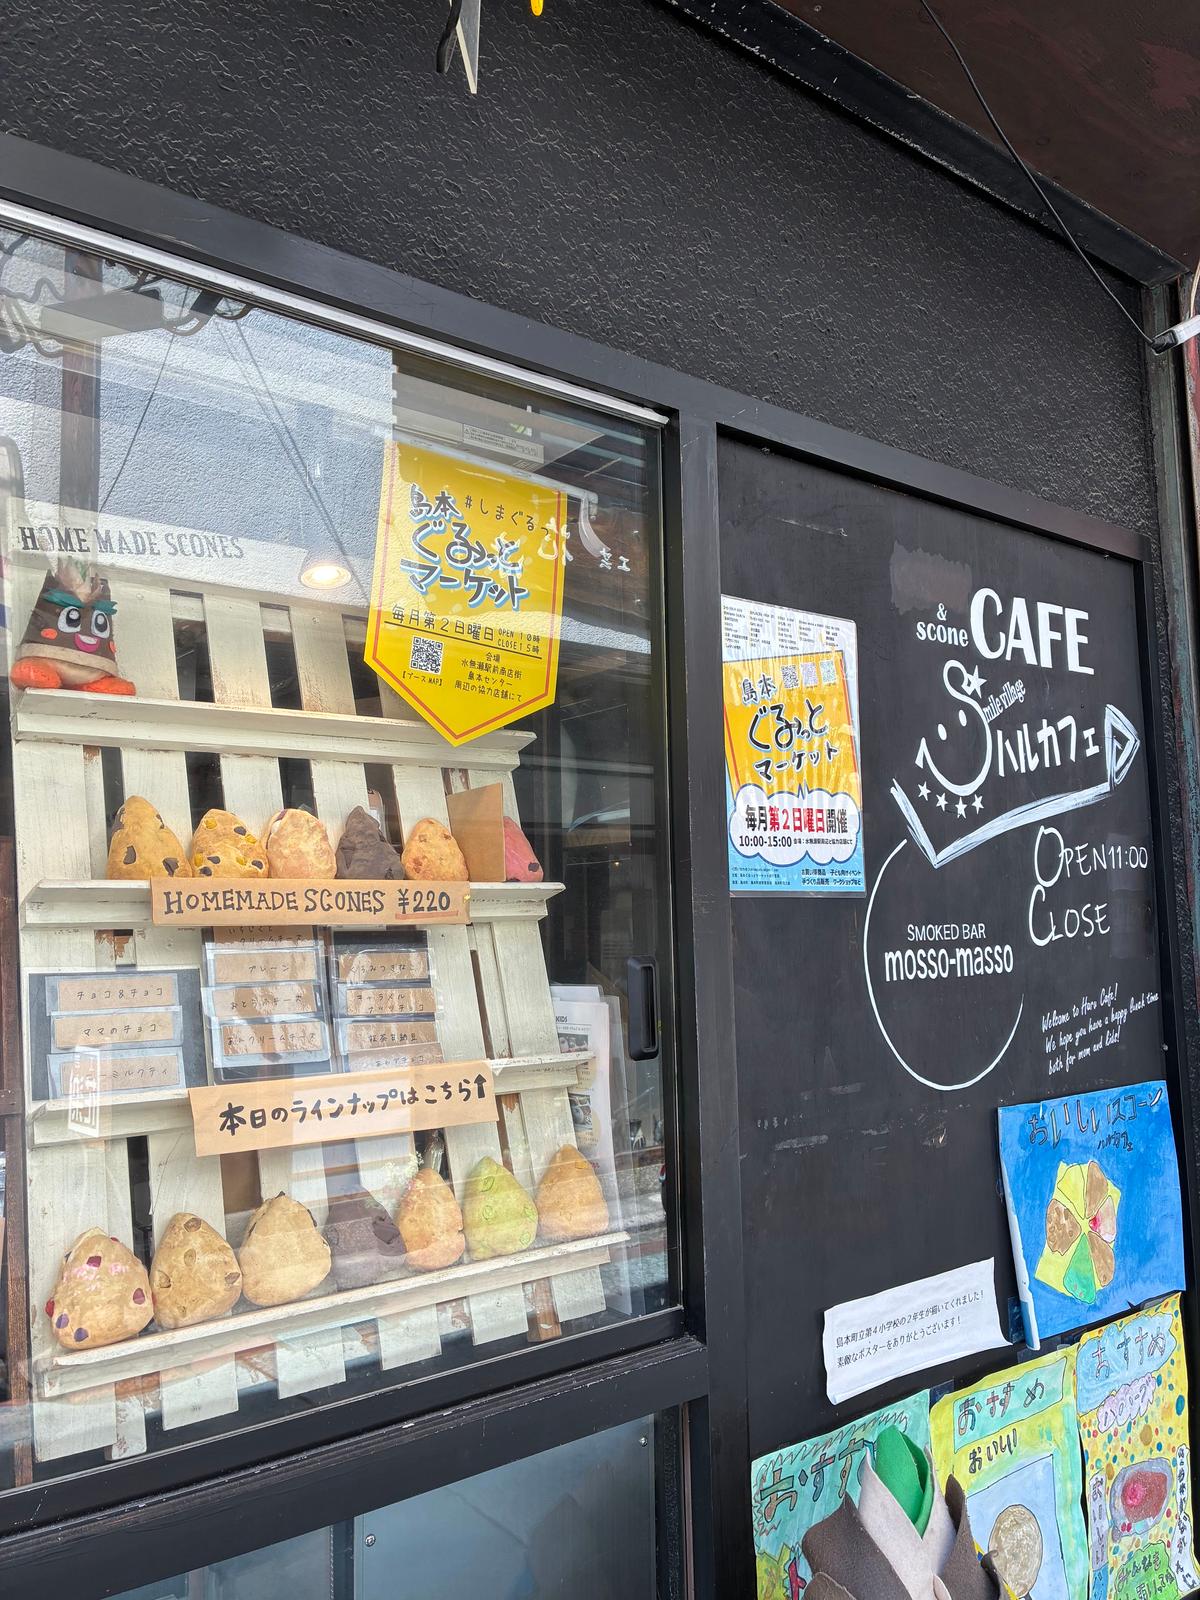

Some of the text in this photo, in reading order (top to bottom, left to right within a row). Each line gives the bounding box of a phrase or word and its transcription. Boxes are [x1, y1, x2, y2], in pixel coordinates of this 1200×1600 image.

[409, 483, 462, 521] 島本
[18, 526, 246, 559] HOME MADE SCONES
[410, 519, 524, 571] ぐるっと
[400, 557, 531, 609] マーケット
[936, 602, 948, 621] &
[497, 638, 517, 650] CLOSE
[498, 627, 514, 638] OPEN
[916, 587, 1095, 676] scone CAFE
[486, 652, 501, 663] 会場
[467, 671, 513, 687] 島本センター
[741, 673, 776, 702] 島本
[750, 699, 828, 749] ぐるっと
[755, 742, 838, 781] マーケット
[997, 715, 1100, 777] ハルカフェ
[739, 835, 792, 848] 10:00-15:00
[1034, 826, 1148, 888] OPEN 11:00
[164, 888, 451, 915] HOMEMADE SCONES ¥220
[1029, 884, 1110, 946] CLOSE
[907, 923, 986, 941] SMOKED BAR
[885, 944, 1014, 981] mosso-masso
[219, 1078, 472, 1136] 本日のラインナップはこちら
[837, 1317, 961, 1368] 素敵なポスターをありがとうございます！
